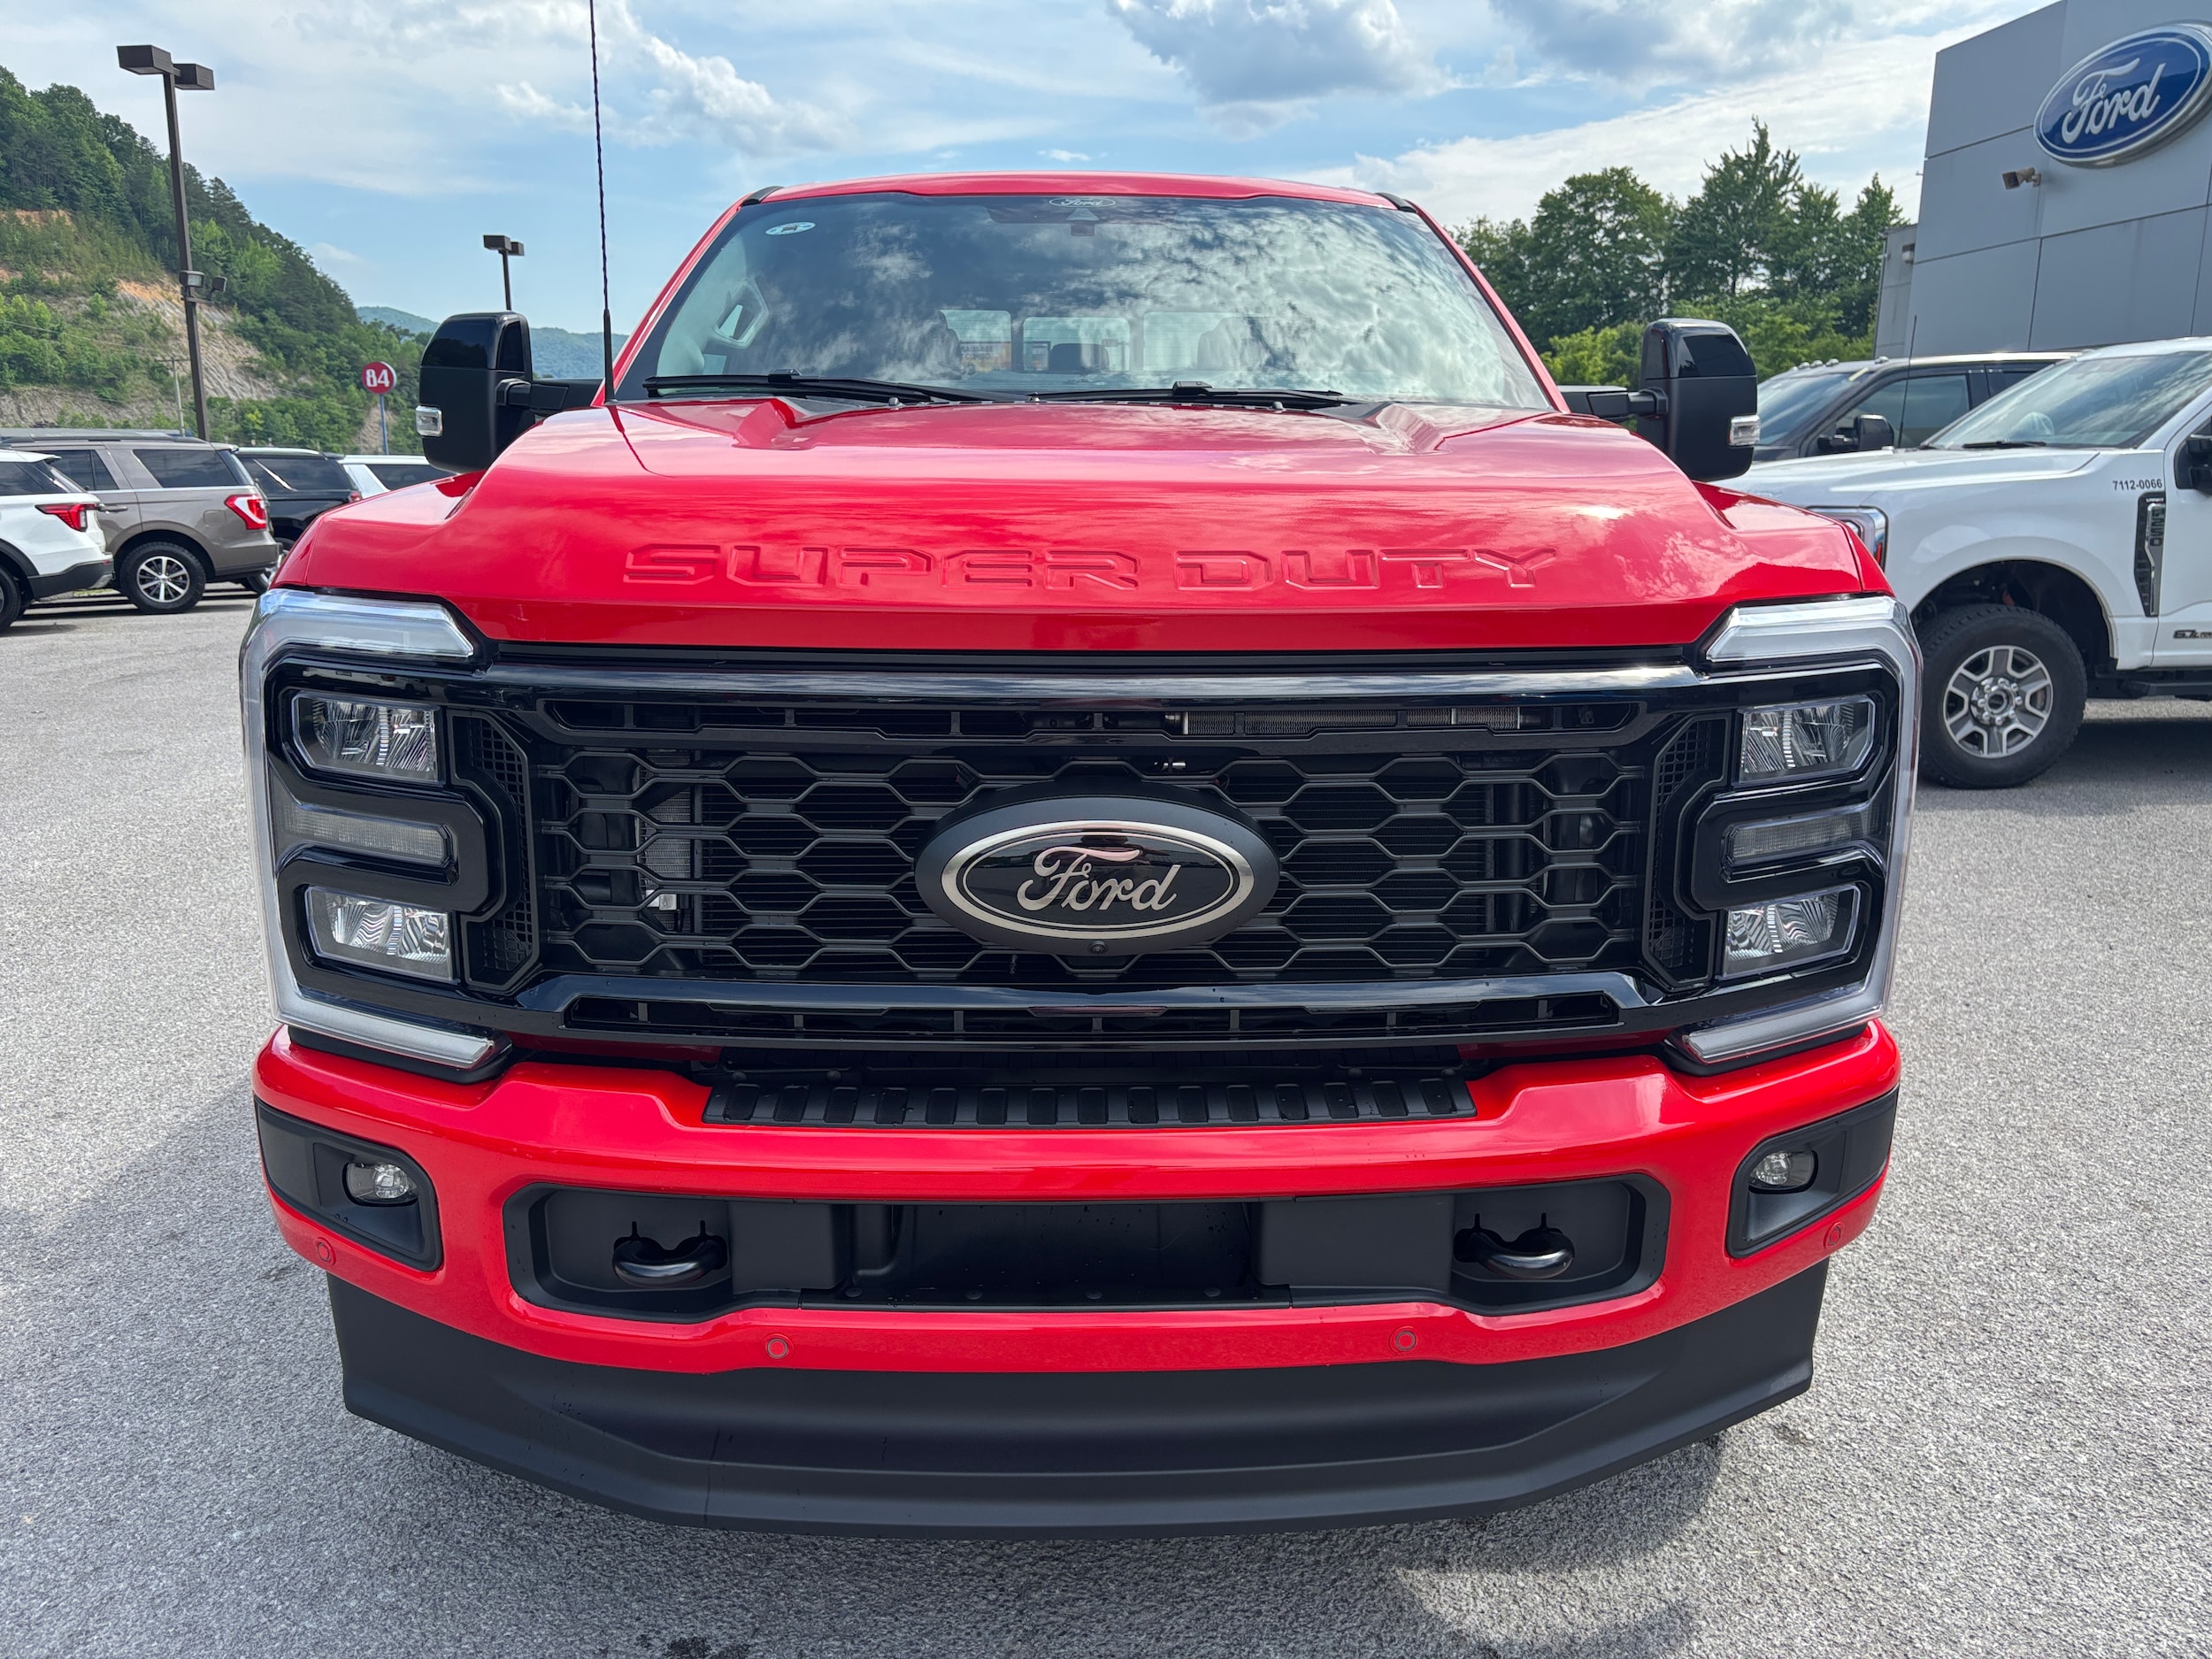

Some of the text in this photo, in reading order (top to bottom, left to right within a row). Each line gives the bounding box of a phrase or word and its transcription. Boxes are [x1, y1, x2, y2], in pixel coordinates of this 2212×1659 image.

[2062, 58, 2167, 143] Ford
[365, 368, 390, 388] 84
[2112, 478, 2163, 491] 7112-0066
[622, 543, 1557, 591] SUPER DUTY
[1017, 846, 1181, 911] Ford
